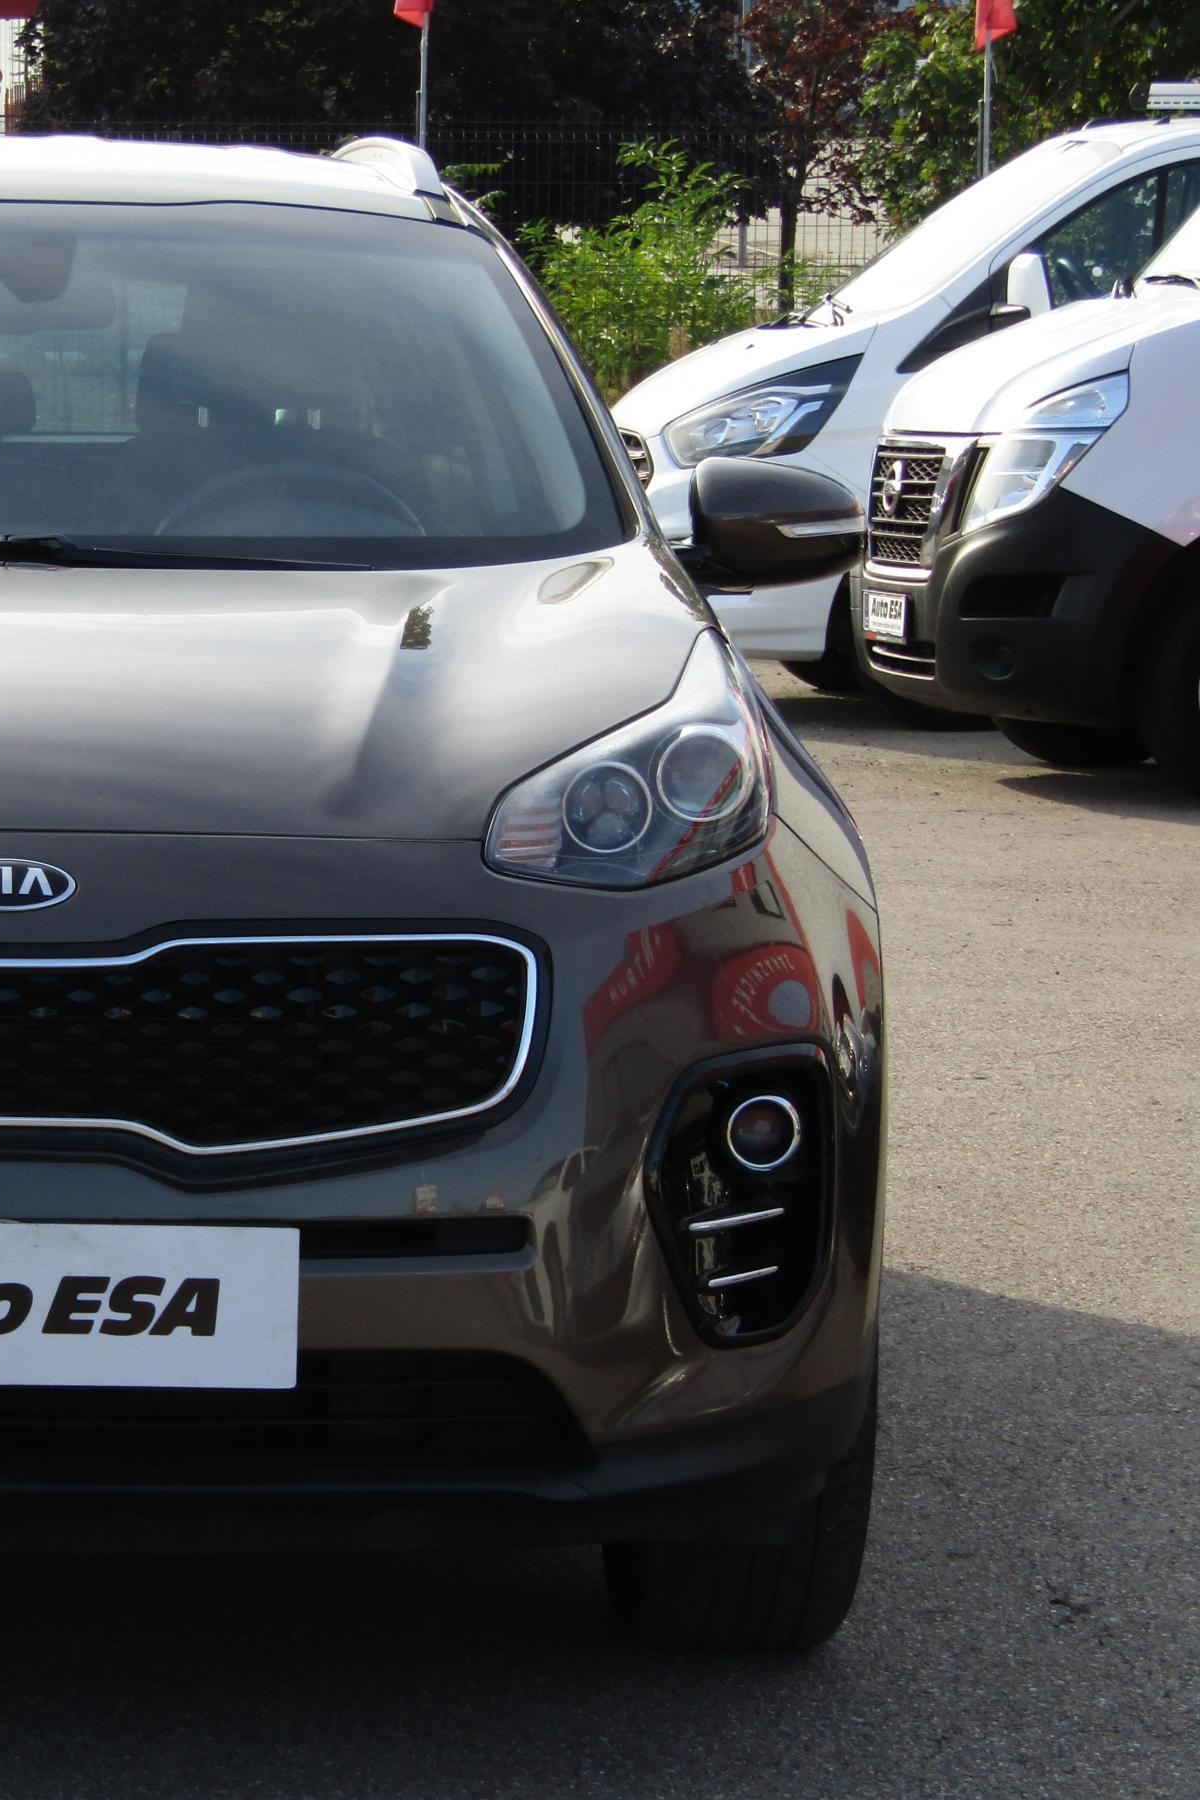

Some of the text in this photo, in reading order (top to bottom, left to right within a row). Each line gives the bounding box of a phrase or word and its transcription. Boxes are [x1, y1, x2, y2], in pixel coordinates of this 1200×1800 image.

[871, 597, 903, 621] Auto ESA
[41, 1275, 220, 1336] ESA
